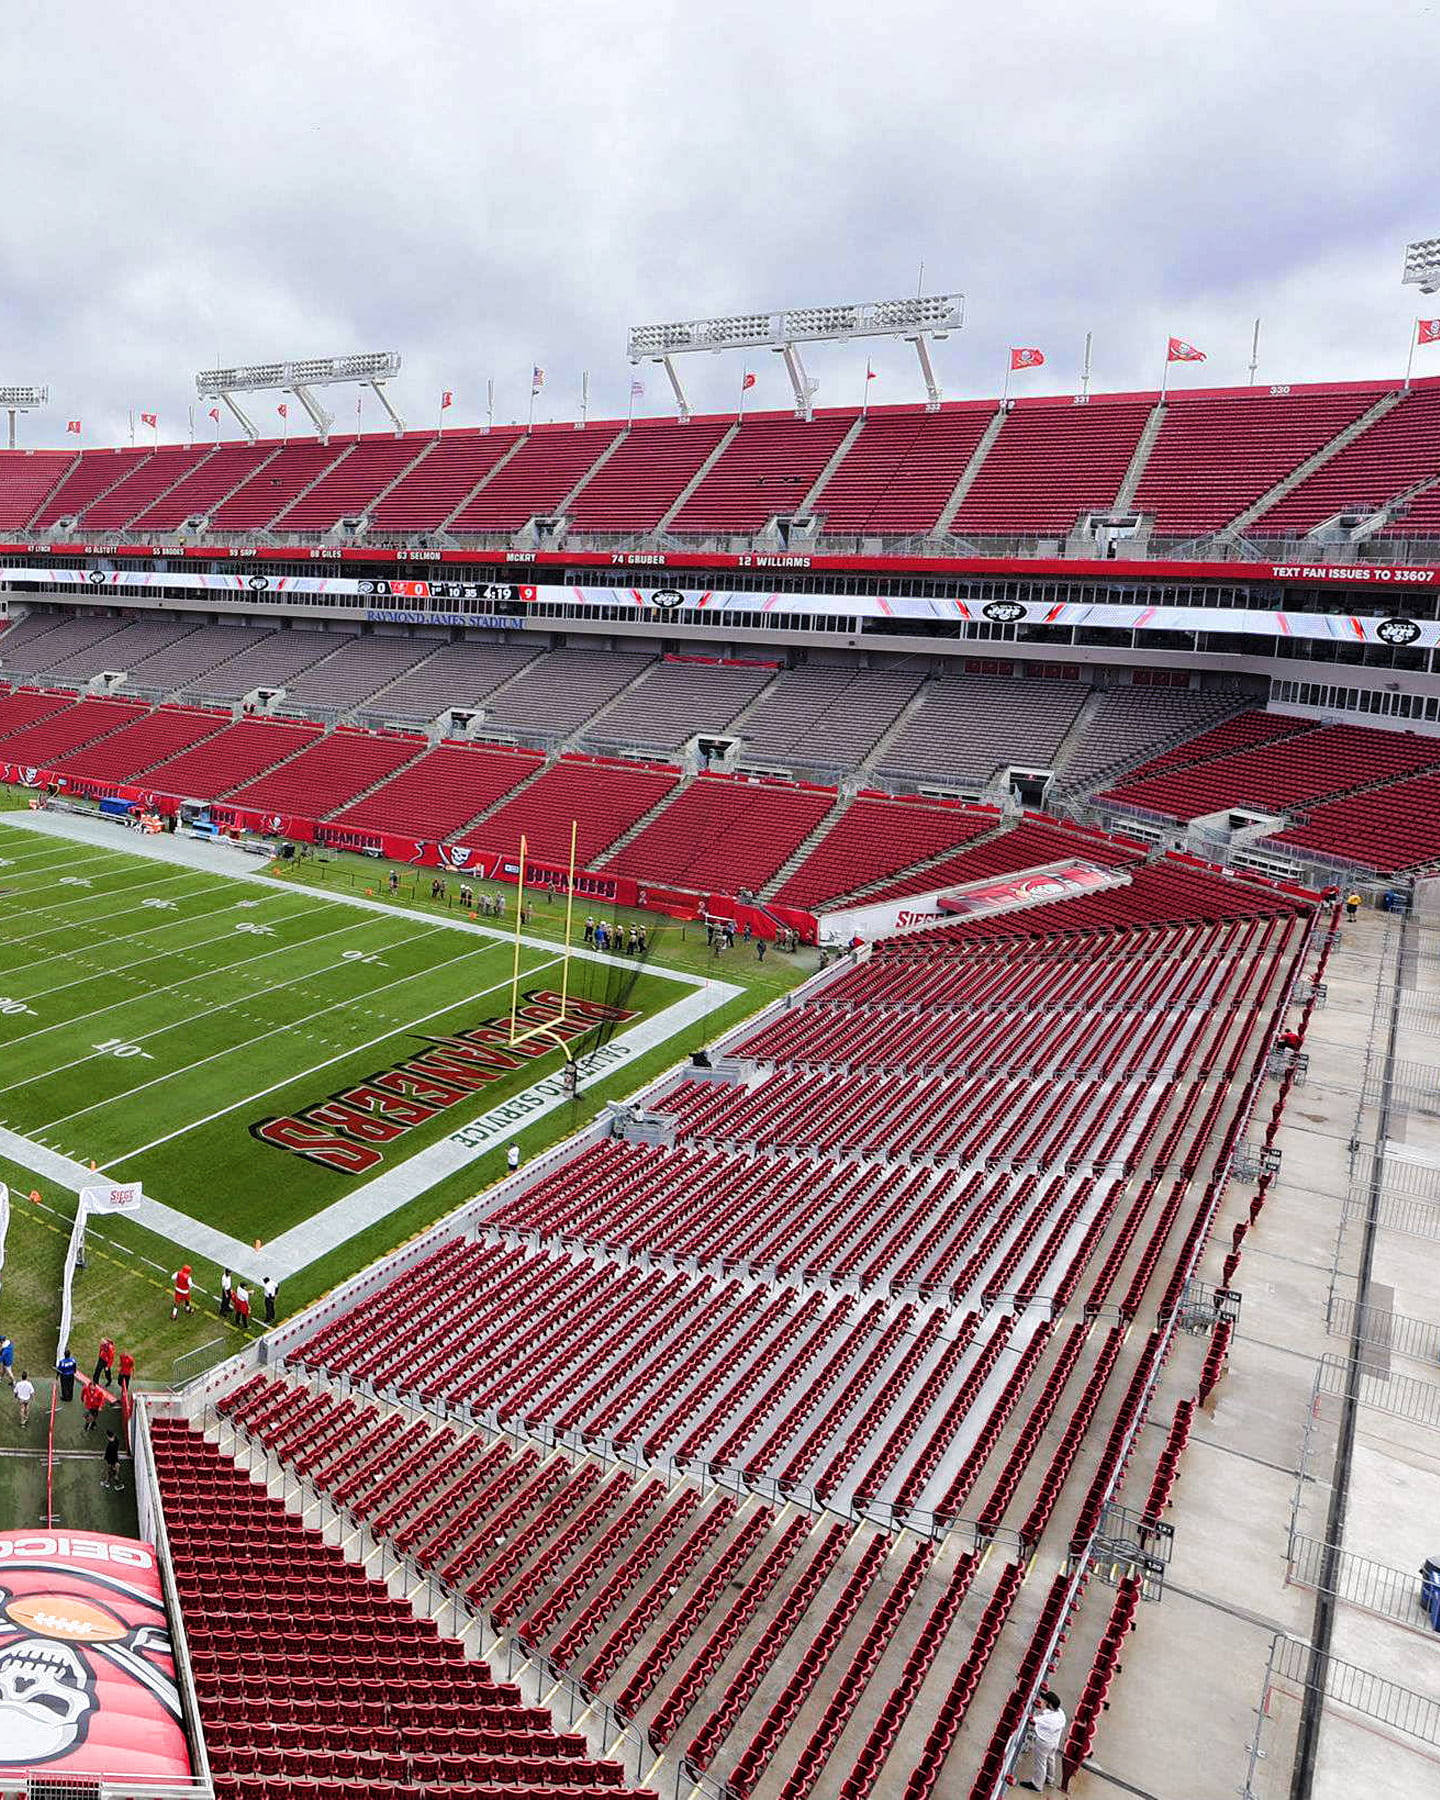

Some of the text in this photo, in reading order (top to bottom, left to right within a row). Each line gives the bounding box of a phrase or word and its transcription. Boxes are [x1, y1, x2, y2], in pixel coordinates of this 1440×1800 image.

[1270, 386, 1290, 395] 330
[322, 549, 342, 558] GILES
[397, 551, 441, 561] 63 SELMON
[506, 553, 536, 562] MCKAY
[611, 555, 665, 565] 74 GRUBER
[738, 556, 811, 568] 12 WILLIAMS
[1272, 566, 1435, 583] TEXT FAN ISSUES TO 33607
[377, 583, 386, 593] 0
[414, 584, 423, 595] 0
[449, 588, 459, 597] 10
[524, 588, 533, 598] 9
[465, 589, 477, 598] 35
[483, 588, 512, 600] 4:19
[367, 610, 525, 630] RAYMOND JAMES STADIUM
[526, 864, 617, 901] BUCCANEERS
[91, 1038, 142, 1058] 10
[248, 989, 643, 1176] BUCCANEERS
[449, 1092, 545, 1149] SERVICE
